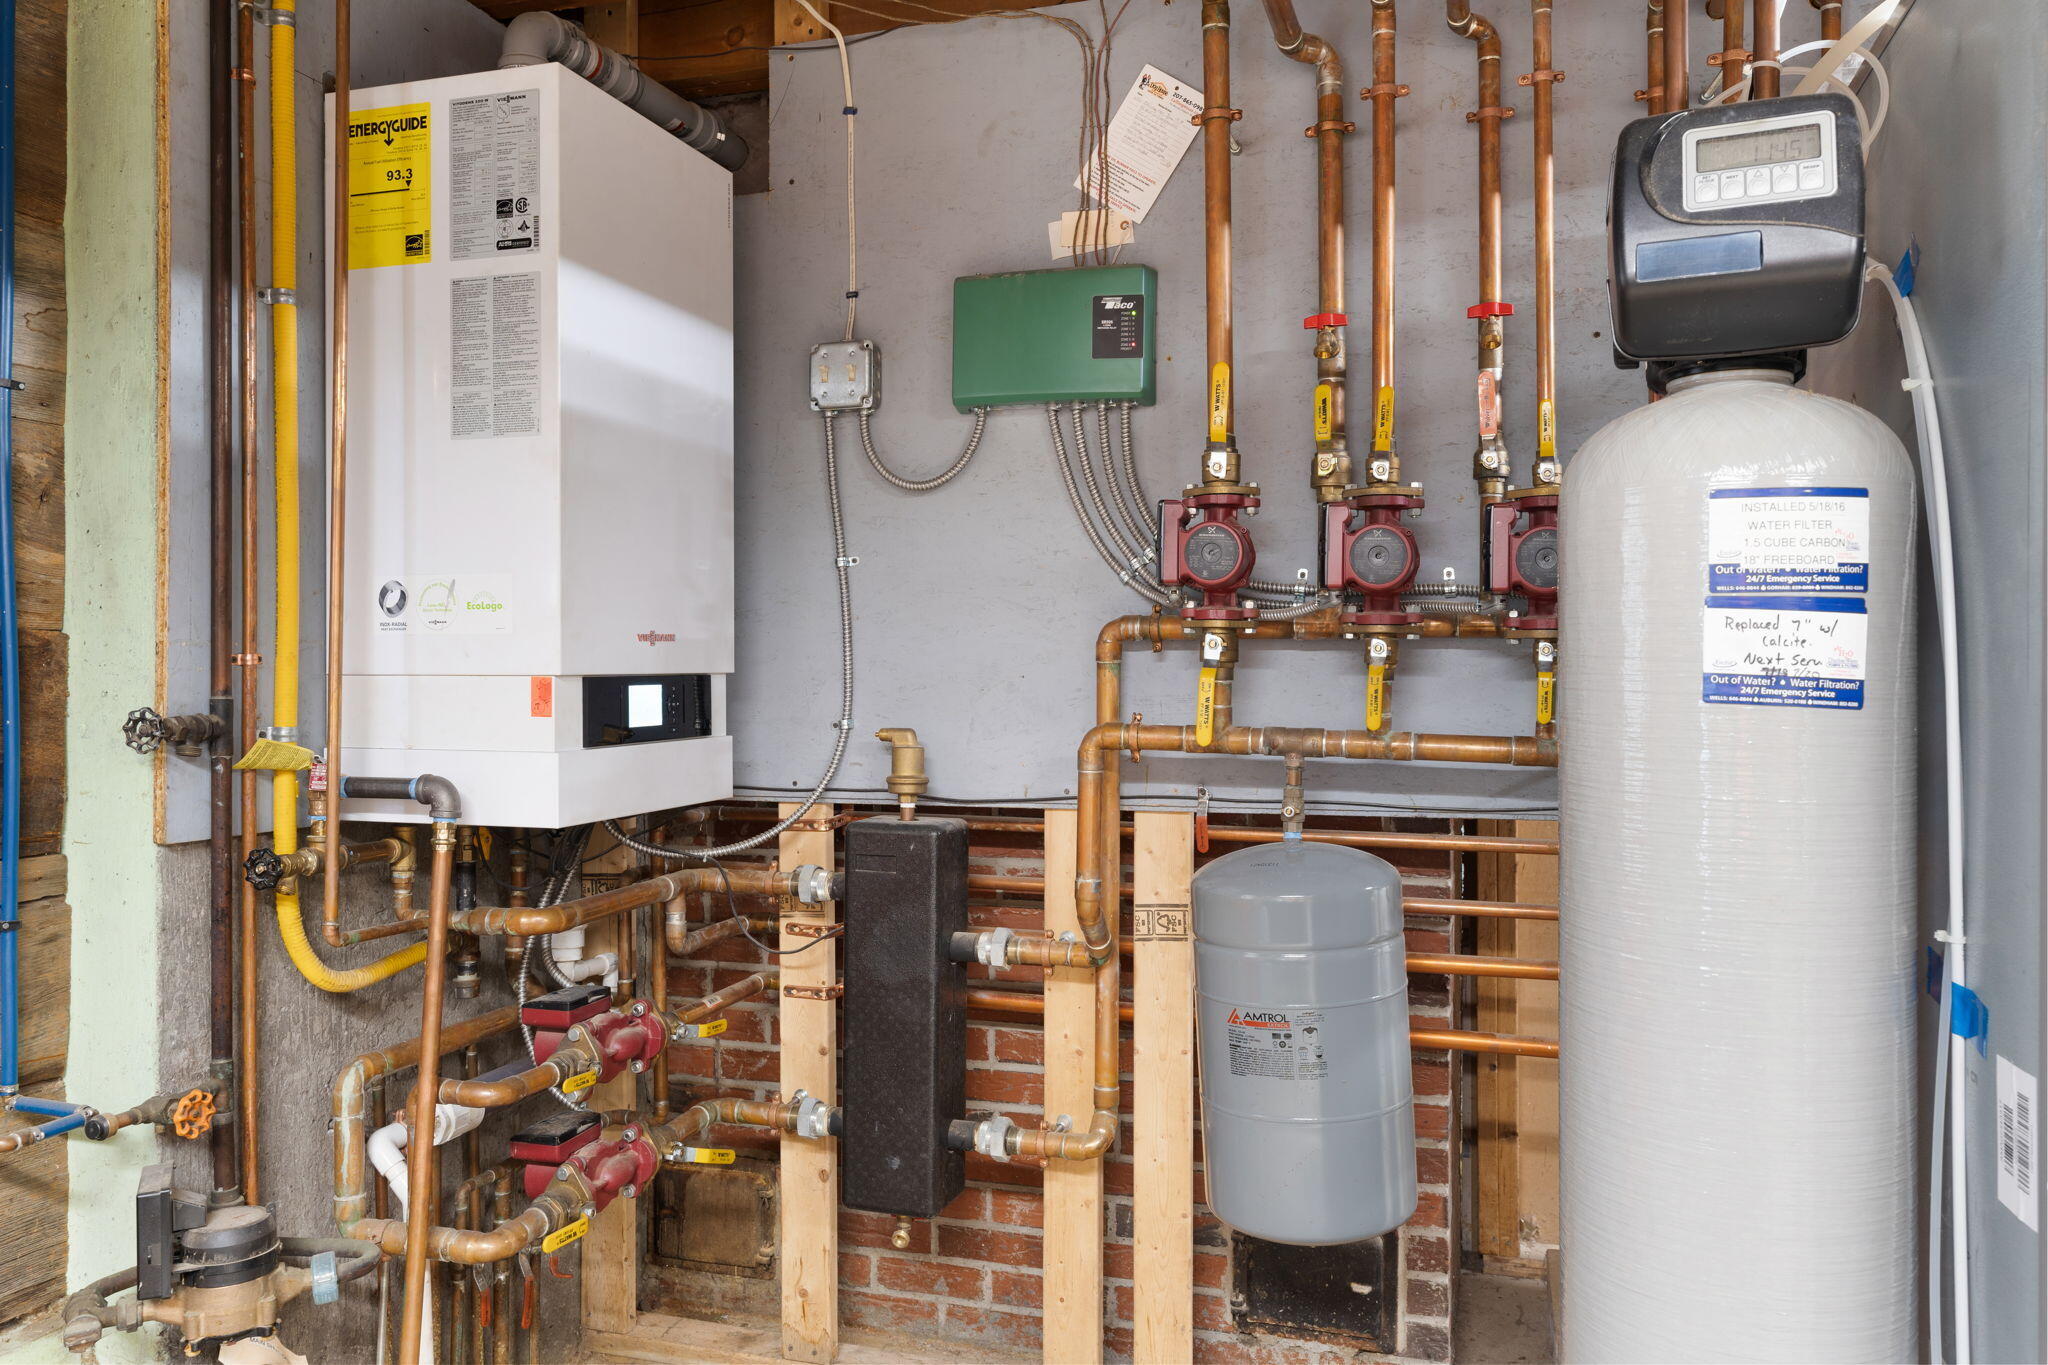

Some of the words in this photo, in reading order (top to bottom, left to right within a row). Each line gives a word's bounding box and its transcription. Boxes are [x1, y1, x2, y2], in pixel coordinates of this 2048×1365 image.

[1172, 92, 1205, 112] 207-865-098
[386, 168, 413, 181] 93.3
[1742, 502, 1806, 512] INSTALLED
[1809, 502, 1846, 512] 5/18/16
[1748, 520, 1790, 530] WATER
[1794, 520, 1832, 529] FILTER
[1744, 538, 1761, 547] 1.5
[1764, 538, 1796, 547] CUBE
[1800, 538, 1846, 547] CARBON
[1764, 555, 1835, 564] FREEBOARD
[1715, 566, 1734, 574] Out
[1766, 575, 1812, 584] Emergency
[1813, 574, 1840, 582] Service
[466, 602, 503, 612] EcoLogo
[1725, 614, 1780, 632] Replaced
[1743, 652, 1784, 666] Next
[1710, 675, 1728, 683] Out
[1731, 676, 1742, 684] of
[1742, 677, 1776, 686] Water?
[1790, 678, 1818, 687] Water
[1819, 680, 1859, 690] Filtration?
[1740, 686, 1759, 694] 24/7
[1761, 687, 1807, 697] Emergency
[1808, 689, 1836, 698] Service
[1244, 1012, 1289, 1022] AMTROL
